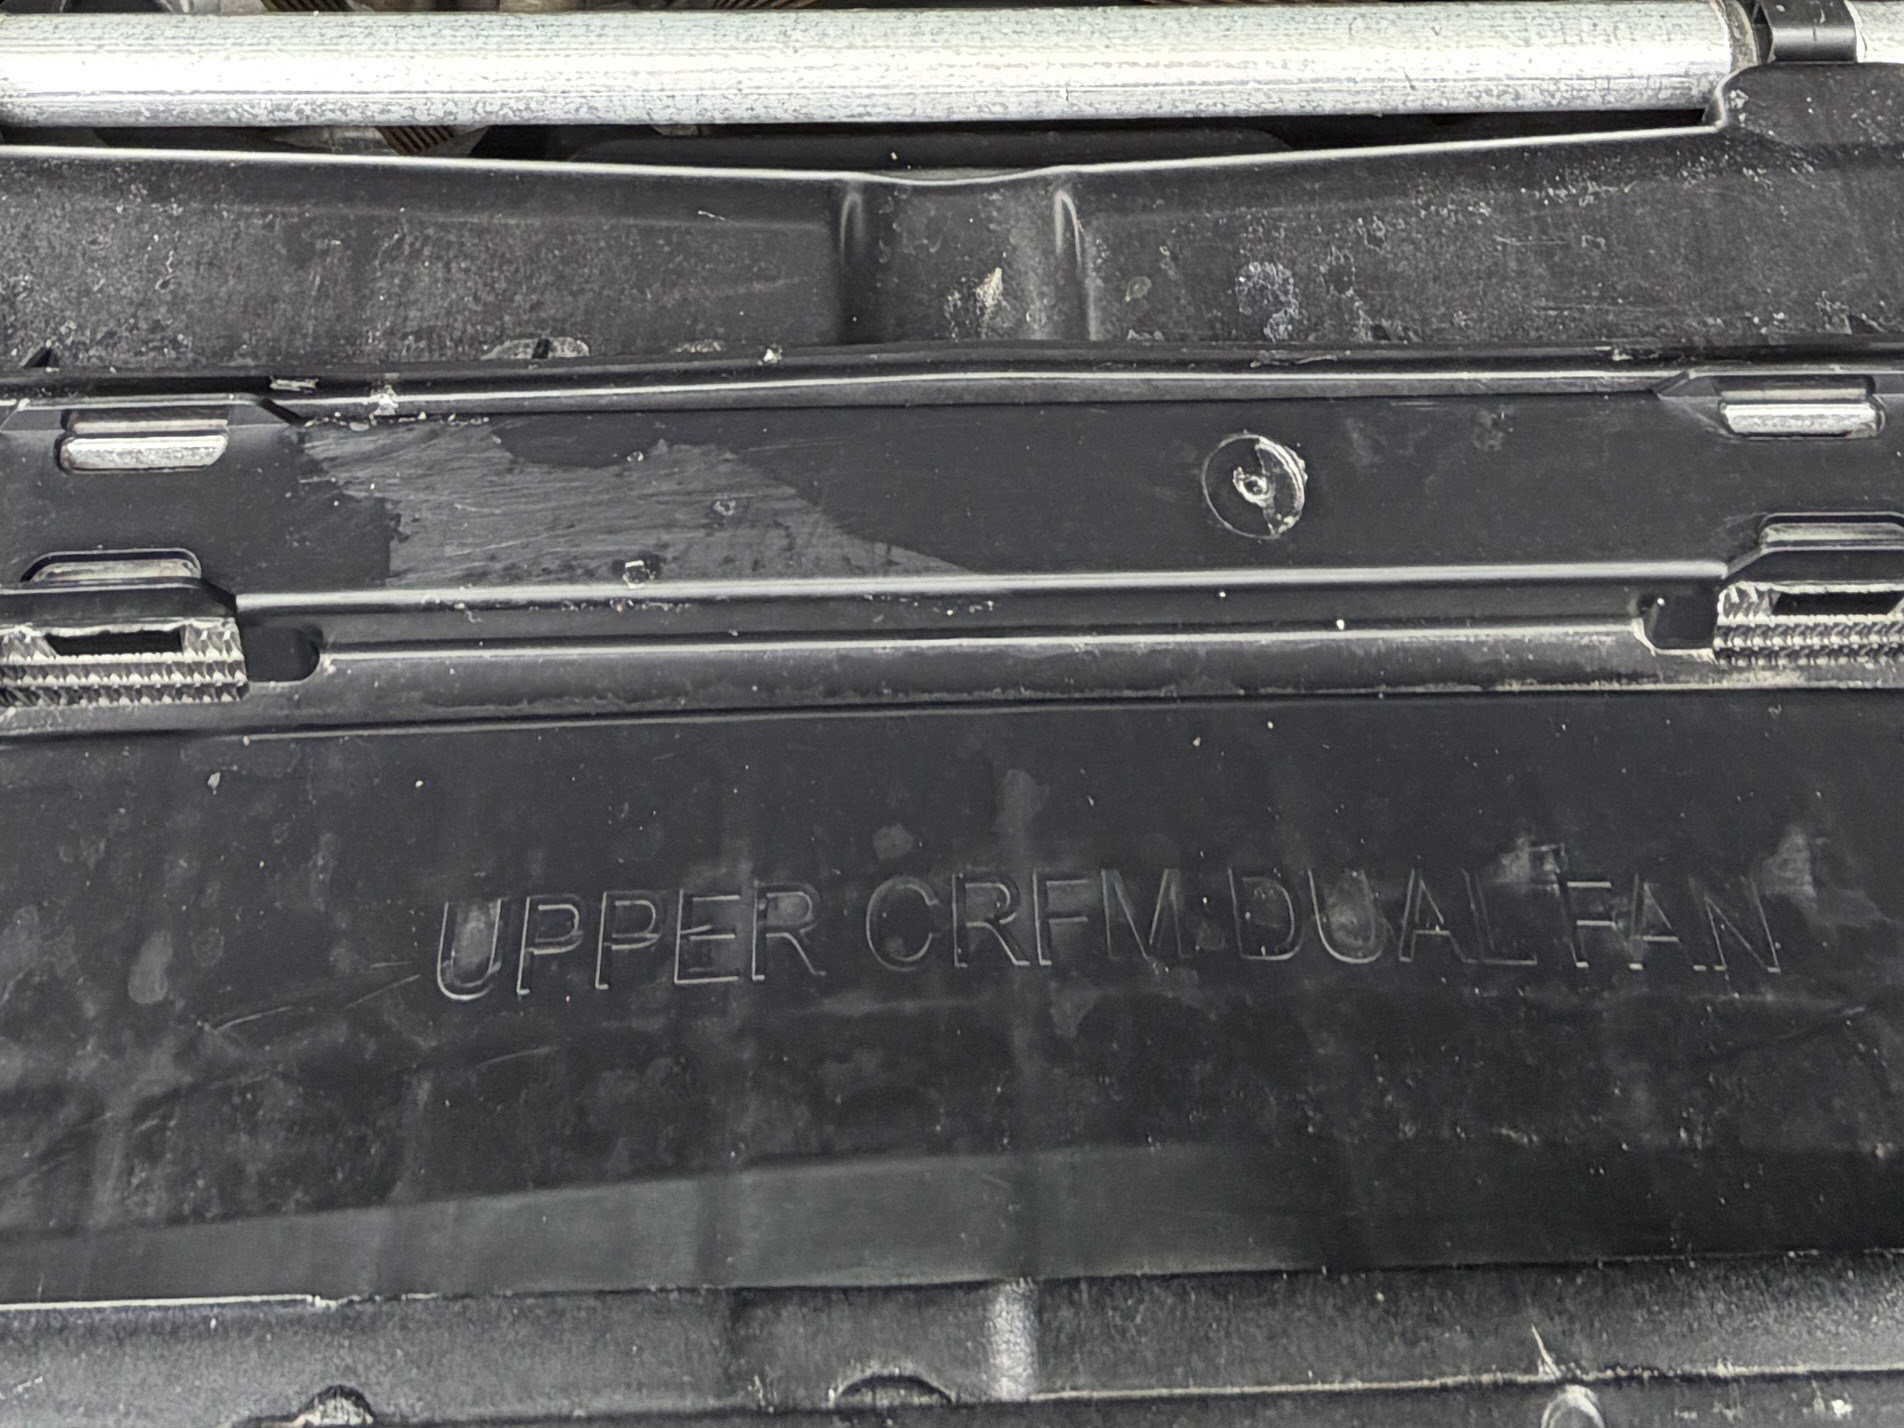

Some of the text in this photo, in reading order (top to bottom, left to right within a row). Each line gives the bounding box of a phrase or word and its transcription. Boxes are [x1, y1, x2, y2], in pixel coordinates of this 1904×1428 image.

[436, 866, 1783, 1002] UPPER CRFM DUAL FAN
